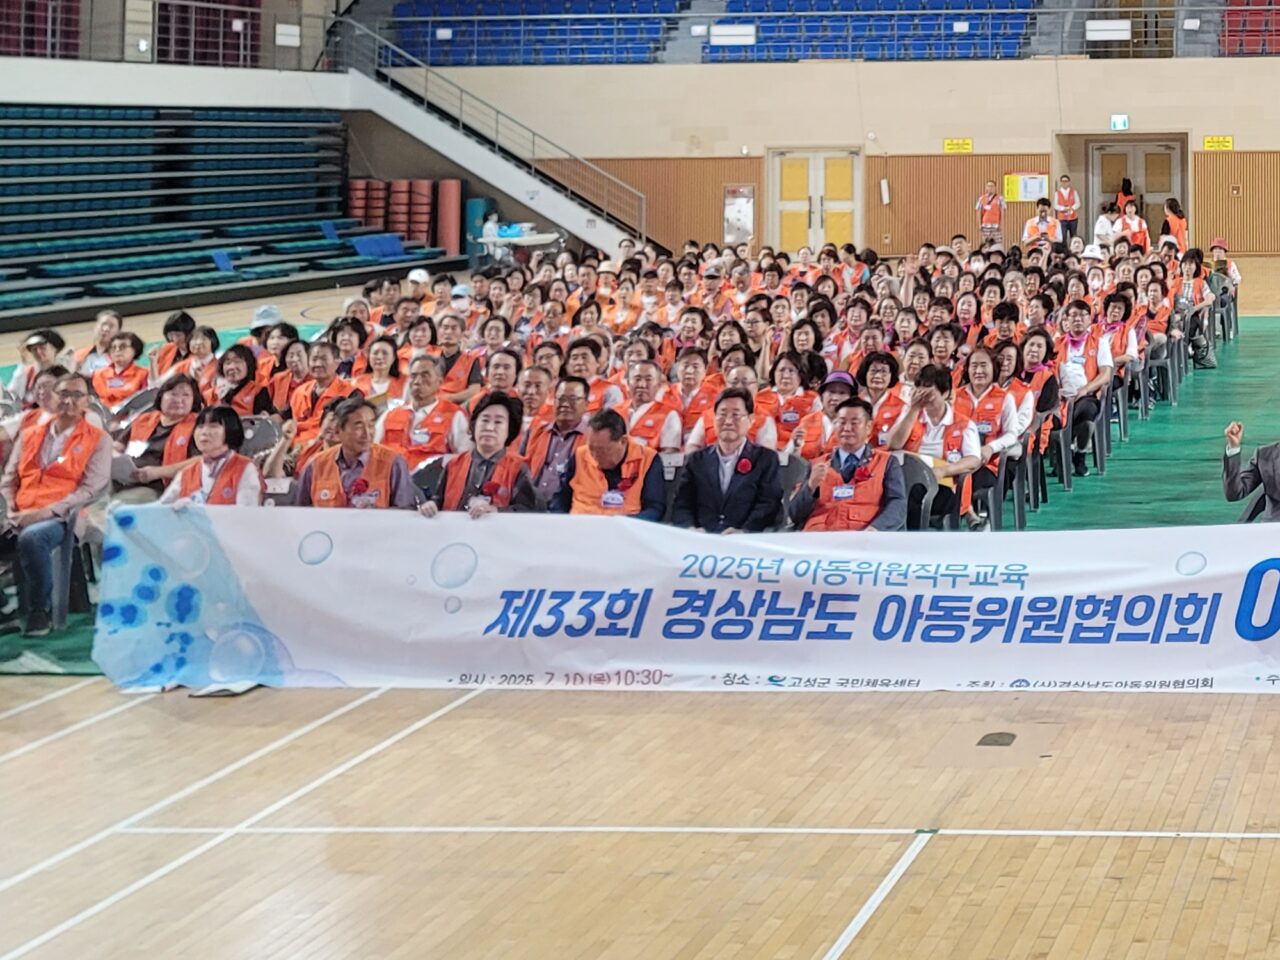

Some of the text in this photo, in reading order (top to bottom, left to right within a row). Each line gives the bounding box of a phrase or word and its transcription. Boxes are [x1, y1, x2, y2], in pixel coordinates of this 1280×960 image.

[679, 554, 1029, 590] 2025년 아동위원직무교육
[482, 588, 653, 639] 제33회
[661, 589, 860, 641] 경상남도
[872, 592, 1222, 645] 아동위원협의회
[722, 672, 750, 686] 장소
[788, 676, 831, 688] 고성군
[836, 678, 921, 688] 국민체육센터
